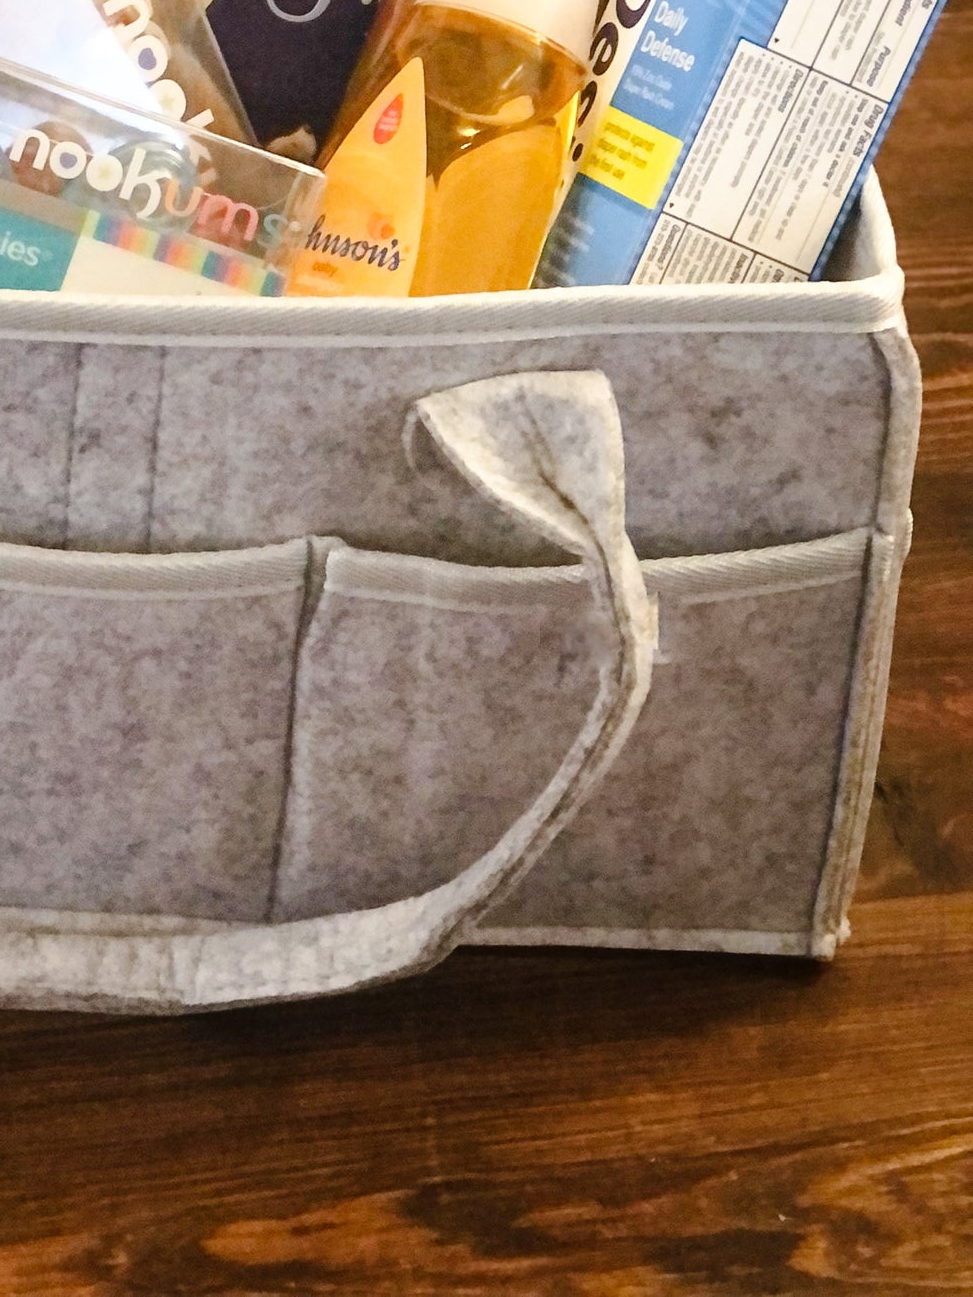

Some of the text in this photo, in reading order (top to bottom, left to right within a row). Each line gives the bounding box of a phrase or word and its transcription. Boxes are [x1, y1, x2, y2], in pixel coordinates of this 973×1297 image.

[654, 1, 689, 37] Daily
[640, 30, 695, 72] Defense
[865, 45, 890, 87] Purpose
[777, 69, 803, 113] Directions
[864, 103, 883, 129] Drug
[853, 129, 871, 157] Facts
[9, 127, 289, 251] nookums
[305, 214, 405, 271] hnson's
[654, 224, 681, 269] Questions?
